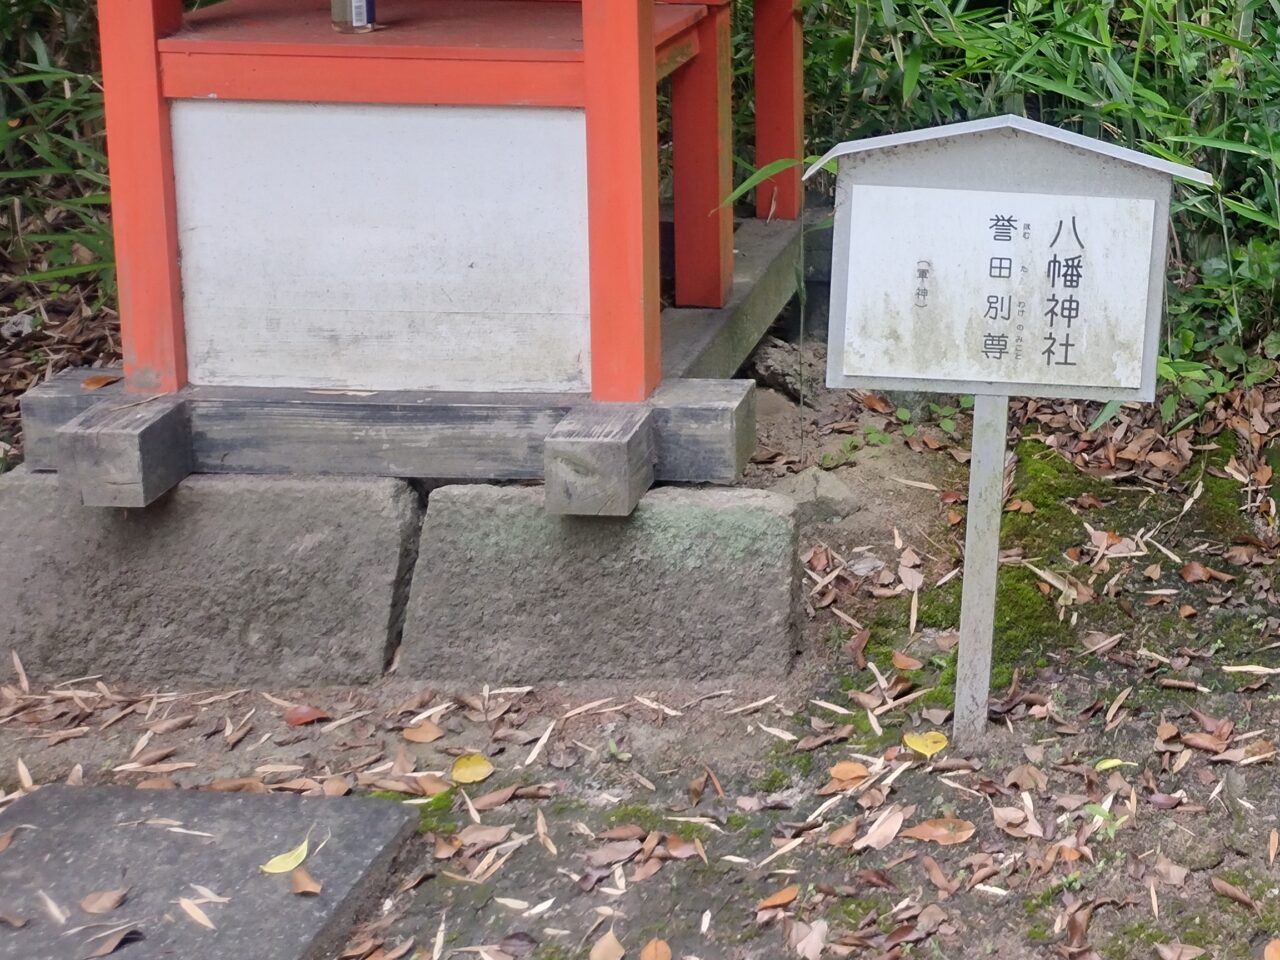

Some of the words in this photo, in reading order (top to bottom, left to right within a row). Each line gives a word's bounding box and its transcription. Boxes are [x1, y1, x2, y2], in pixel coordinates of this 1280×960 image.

[981, 214, 1018, 360] 誉田別尊
[1041, 216, 1085, 366] 八幡神社
